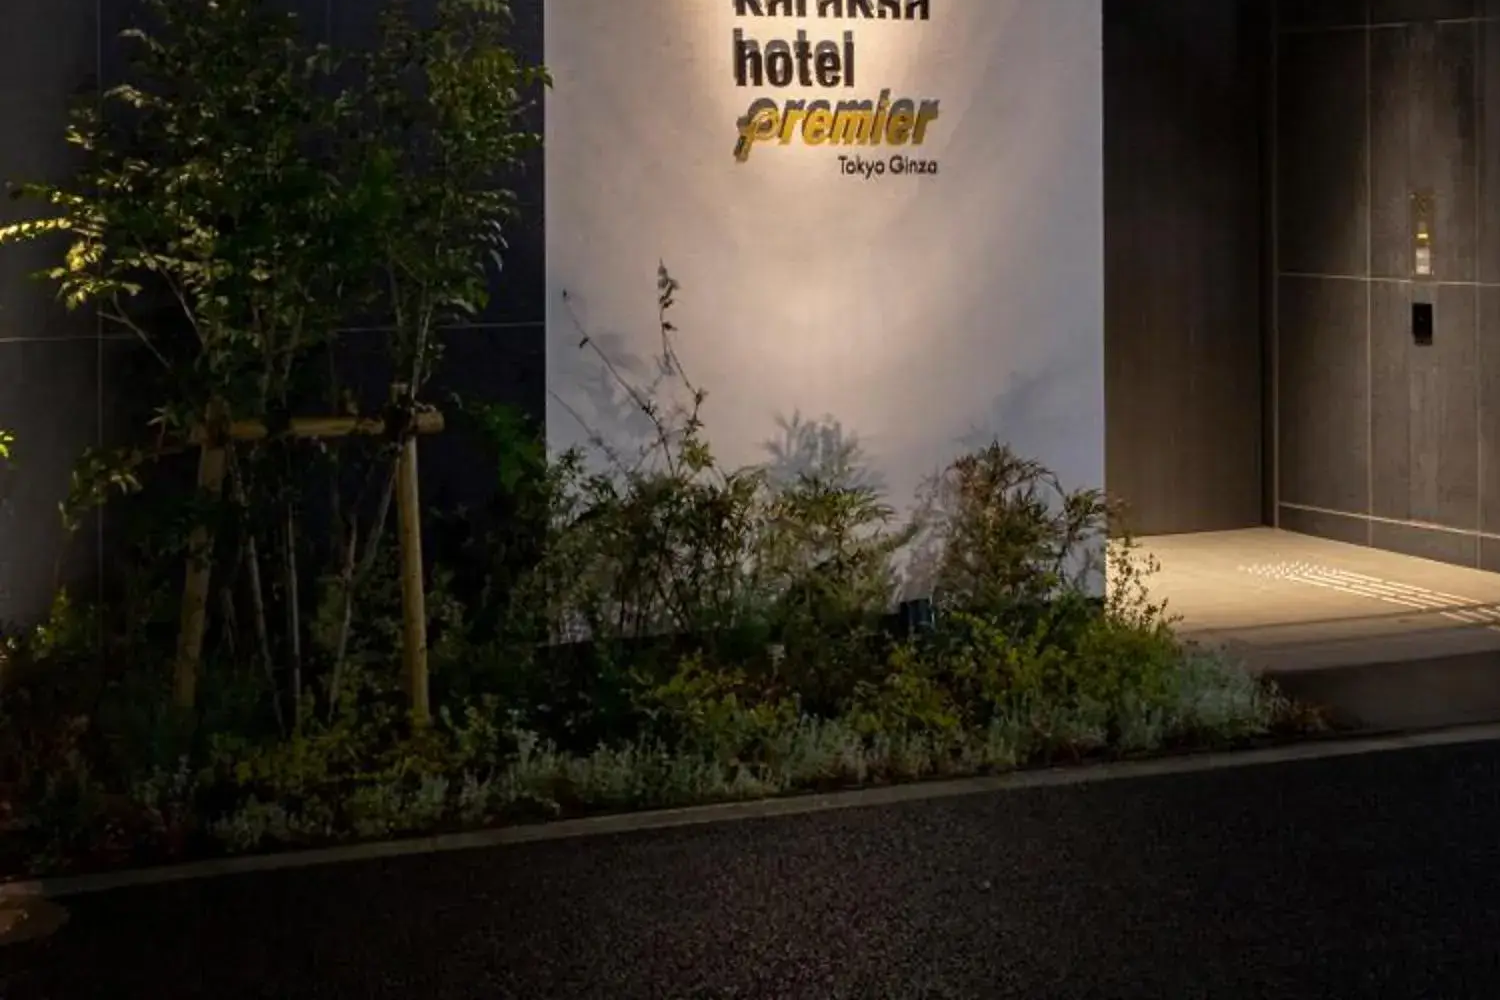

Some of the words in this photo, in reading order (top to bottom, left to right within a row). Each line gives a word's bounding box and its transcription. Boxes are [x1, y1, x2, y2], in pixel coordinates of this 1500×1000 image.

[733, 28, 855, 86] hotel
[838, 155, 885, 179] Tokyo
[889, 156, 937, 174] Ginza
